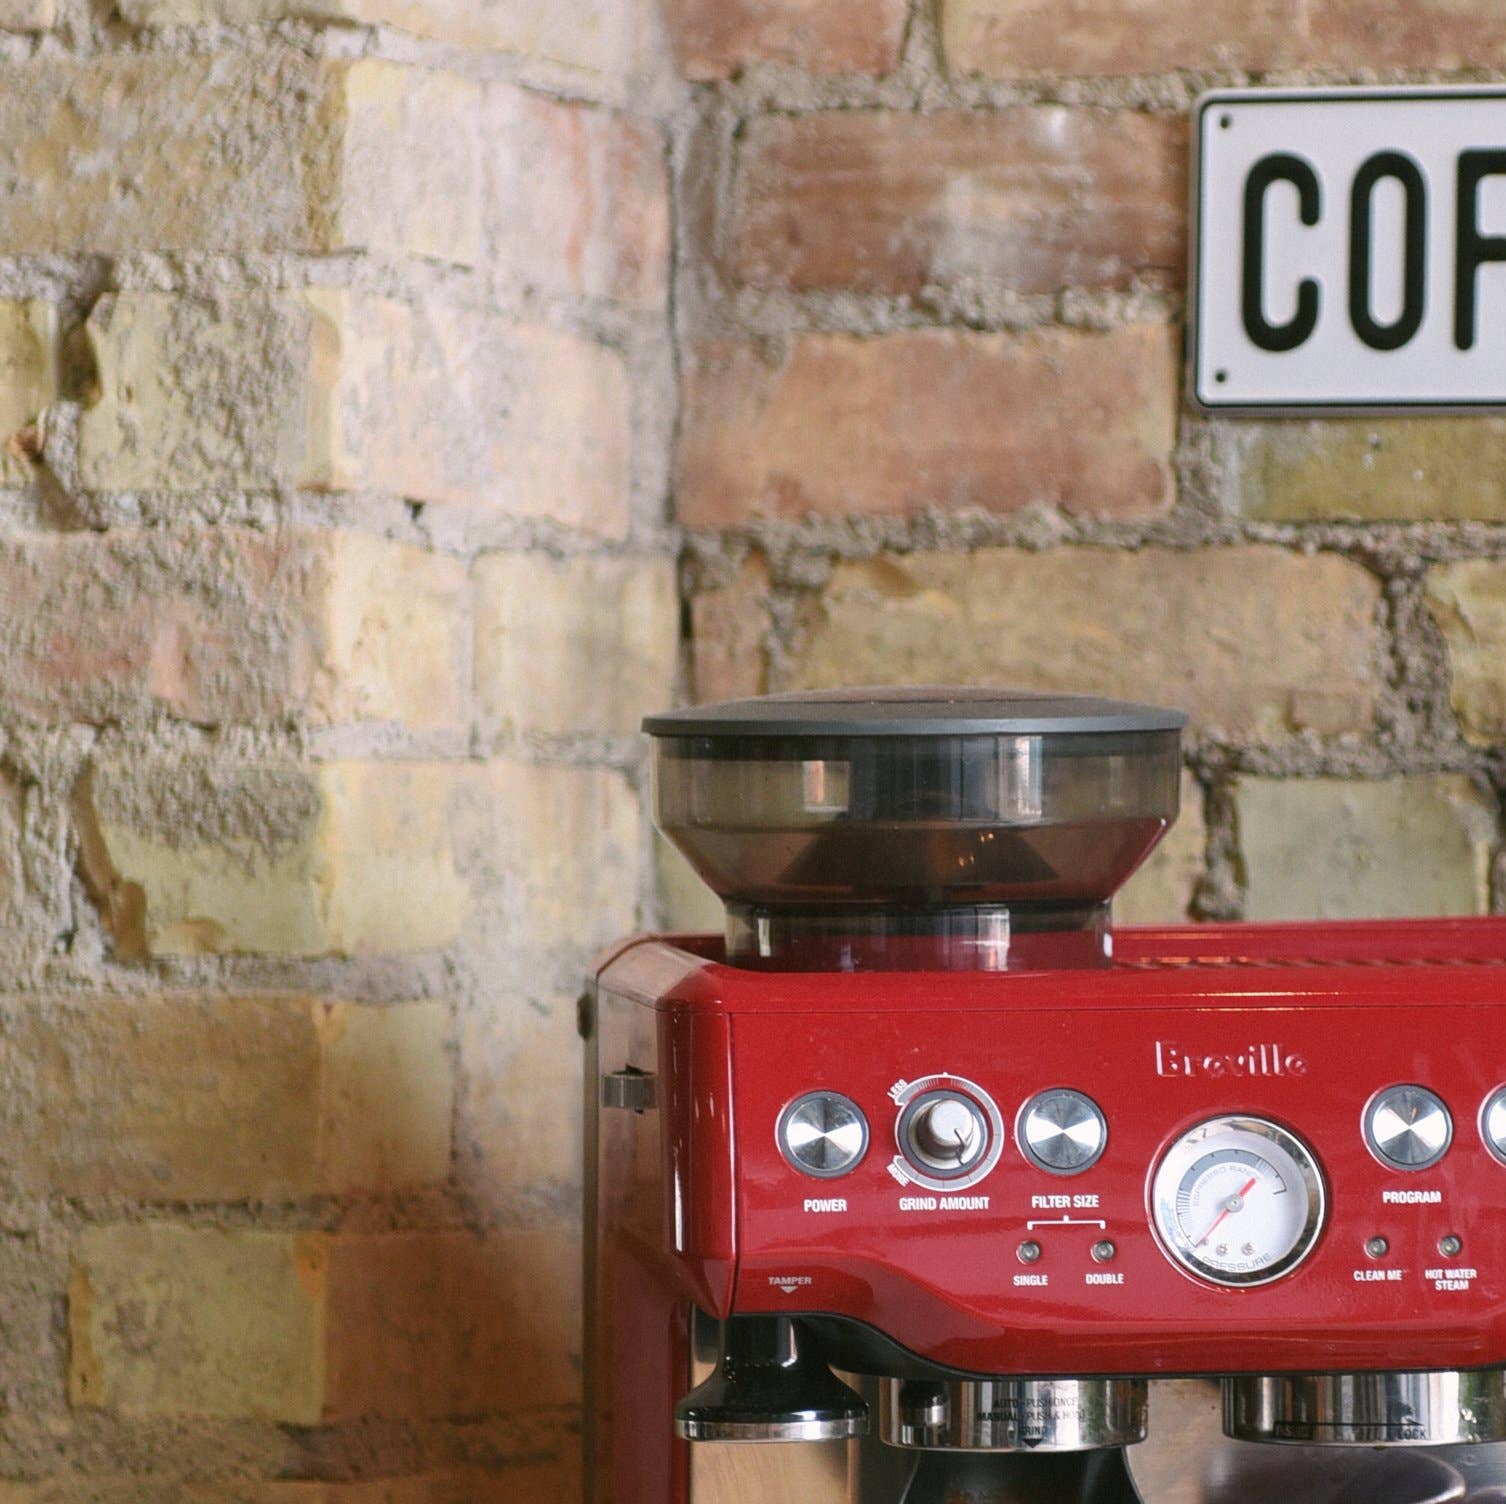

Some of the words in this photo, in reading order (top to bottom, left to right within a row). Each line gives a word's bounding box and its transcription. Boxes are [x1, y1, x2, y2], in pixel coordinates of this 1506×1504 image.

[1154, 1040, 1307, 1077] Breville
[899, 1197, 937, 1210] GRIND
[938, 1196, 990, 1210] AMOUNT
[1031, 1196, 1071, 1209] FILTER
[1072, 1195, 1099, 1208] SIZE
[1382, 1190, 1442, 1204] PROGRAM
[803, 1199, 848, 1213] POWER
[1202, 1251, 1275, 1272] PRESSURE
[1013, 1274, 1048, 1286] SINGLE
[1085, 1273, 1124, 1286] DOUBLE
[1353, 1270, 1386, 1281] CLEAN
[1387, 1269, 1402, 1280] ME
[1424, 1268, 1444, 1279] HOT
[1445, 1268, 1477, 1279] WATER
[768, 1276, 812, 1286] TAMPER
[1435, 1280, 1469, 1291] STEAM
